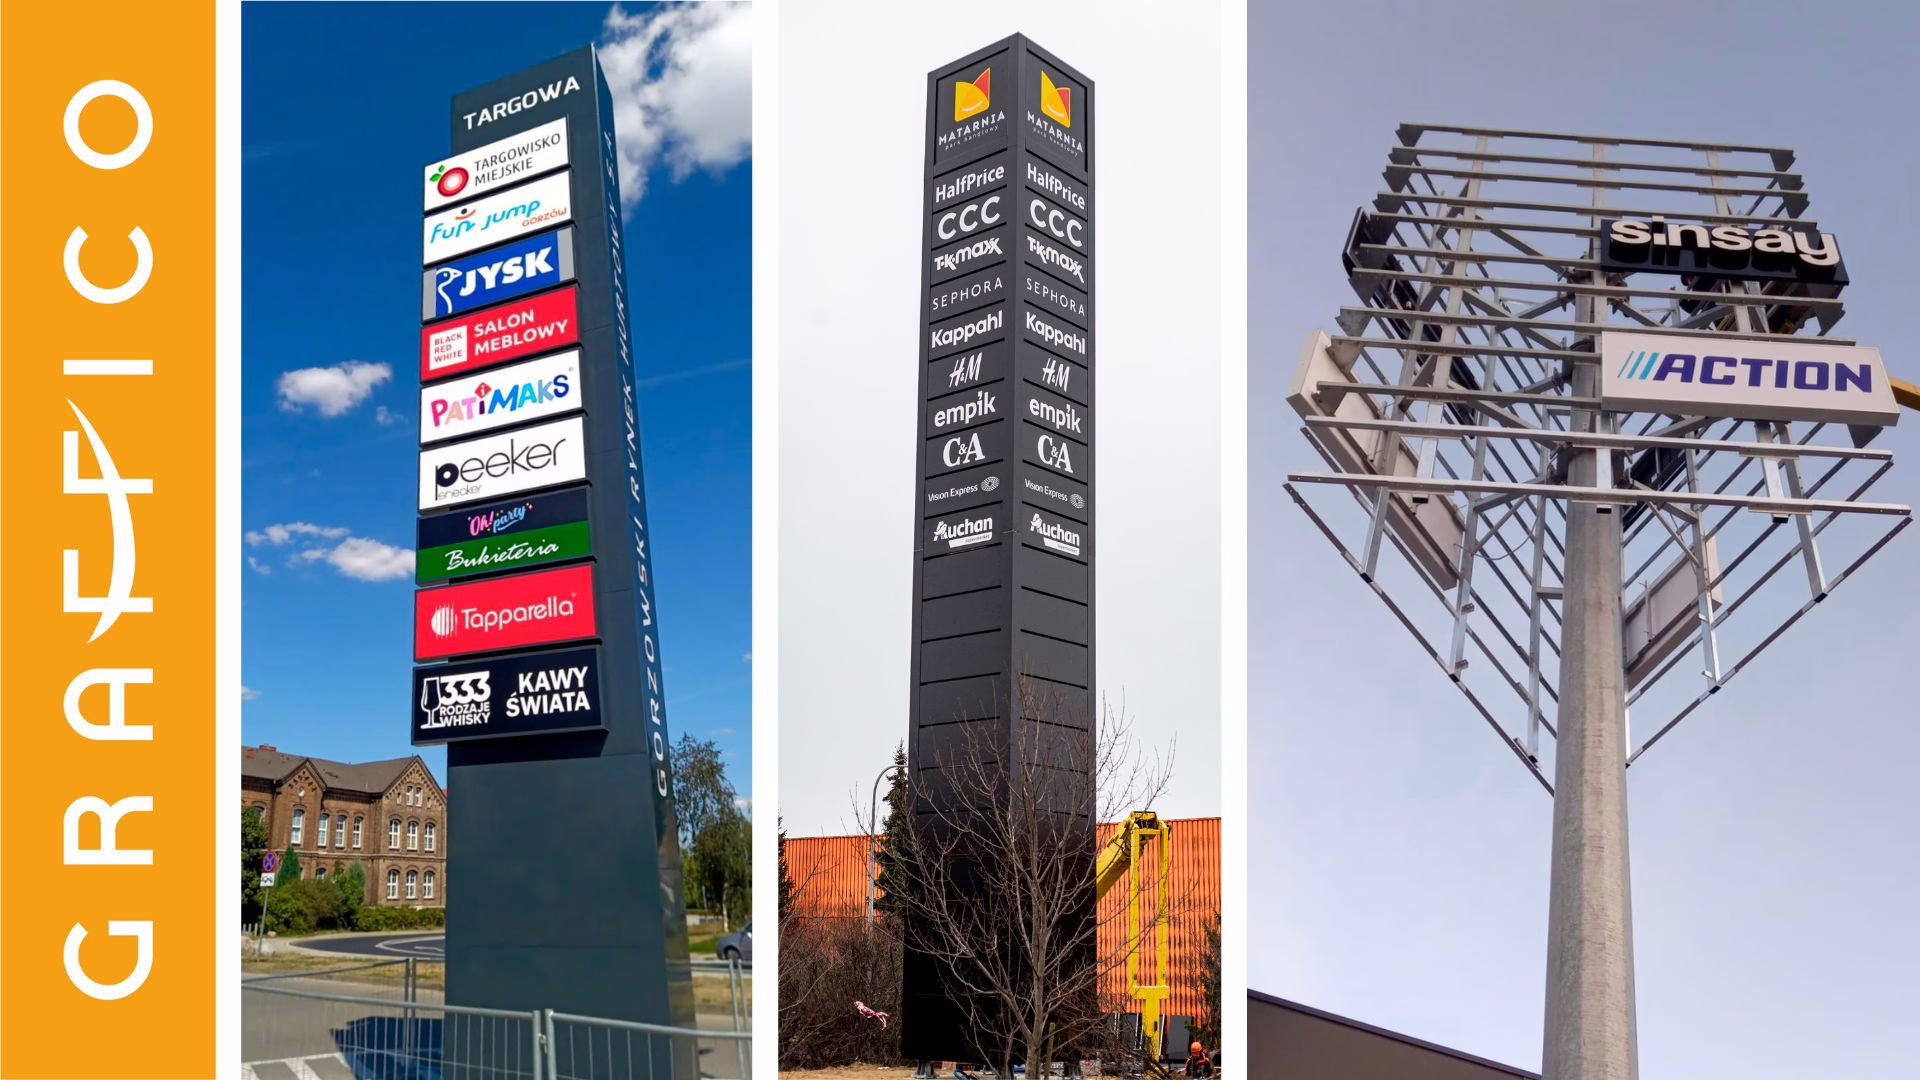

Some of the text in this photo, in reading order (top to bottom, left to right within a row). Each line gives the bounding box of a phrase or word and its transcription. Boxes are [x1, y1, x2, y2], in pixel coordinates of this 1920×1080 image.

[463, 76, 580, 130] TARGOWA
[938, 110, 1005, 146] MATARNIA
[1027, 110, 1083, 153] MATARNIA
[474, 132, 561, 172] TARGOWISKO
[475, 157, 533, 187] MIEJSKIE
[935, 166, 1005, 203] HalfPrice
[1027, 163, 1085, 210] HalfPrice
[522, 207, 567, 227] GORZÓW
[938, 196, 1000, 240] CCC
[1030, 199, 1082, 247] CCC
[1610, 216, 1840, 266] sinsay
[459, 246, 554, 297] JYSK
[932, 277, 1003, 310] SEPHORA
[1026, 277, 1085, 316] SEPHORA
[434, 332, 463, 346] BLACK
[474, 309, 535, 338] SALON
[474, 319, 568, 356] MEBLOWY
[931, 310, 1003, 348] Kappahl
[1026, 311, 1086, 355] Kappahl
[434, 344, 452, 354] RED
[434, 350, 463, 363] WHITE
[949, 352, 983, 388] H&M
[1042, 357, 1070, 392] H&M
[1653, 353, 1872, 393] ACTION
[934, 391, 996, 427] empik
[1029, 398, 1081, 434] empik
[623, 374, 641, 503] RYNEK
[942, 432, 985, 467] C&A
[1037, 434, 1073, 474] C&A
[435, 438, 566, 500] peeker
[438, 483, 482, 500] sneaker
[928, 485, 978, 502] Vision Express
[1025, 478, 1068, 502] Vision Express
[933, 517, 993, 541] Auchan
[1030, 513, 1080, 546] Auchan
[445, 538, 559, 571] Bukieteria
[461, 597, 574, 632] Tapparella
[634, 516, 668, 797] GORZOWSKI
[440, 671, 491, 705] 333
[518, 666, 588, 694] KAWY
[439, 712, 491, 727] WHISKY
[440, 702, 490, 716] RODZAJE
[506, 691, 591, 718] ŚWIATA
